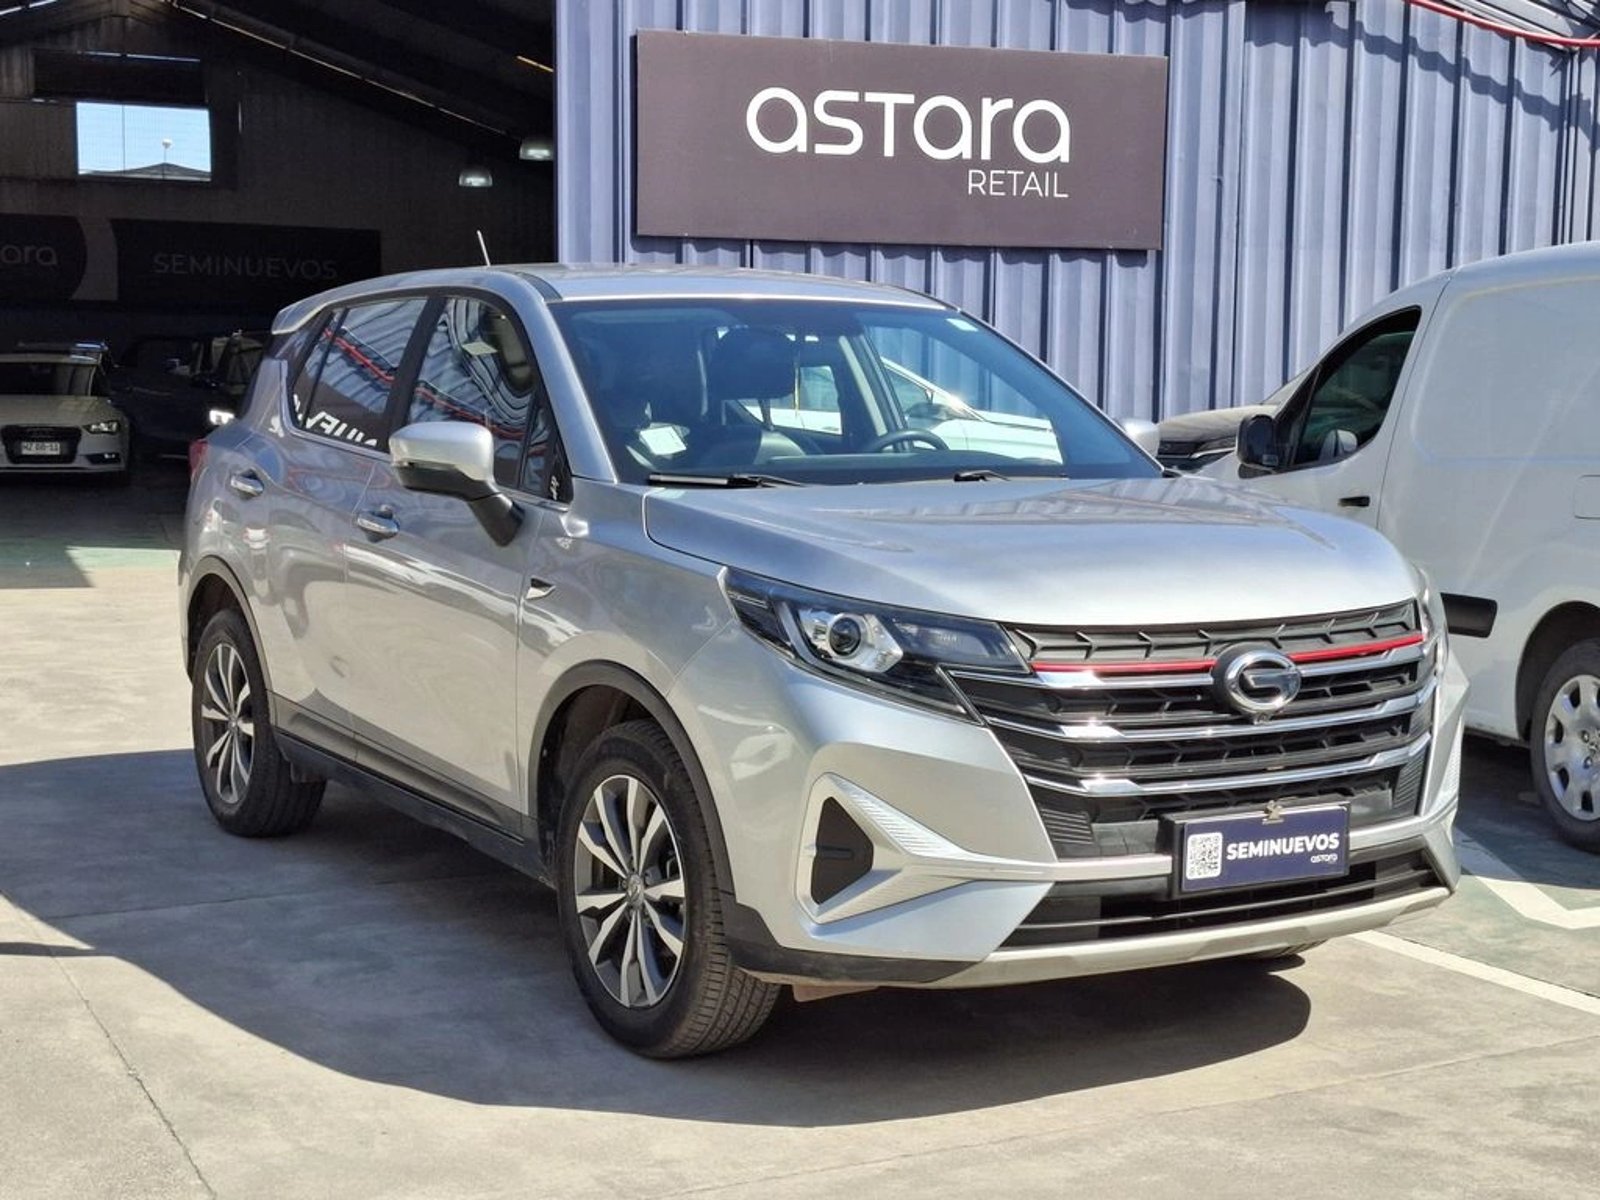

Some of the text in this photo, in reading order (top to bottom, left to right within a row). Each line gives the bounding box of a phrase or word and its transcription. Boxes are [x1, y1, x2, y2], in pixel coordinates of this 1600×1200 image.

[967, 169, 1069, 198] RETAIL
[152, 252, 338, 280] SEMINUEVOS
[1226, 832, 1340, 861] SEMINUEVOS
